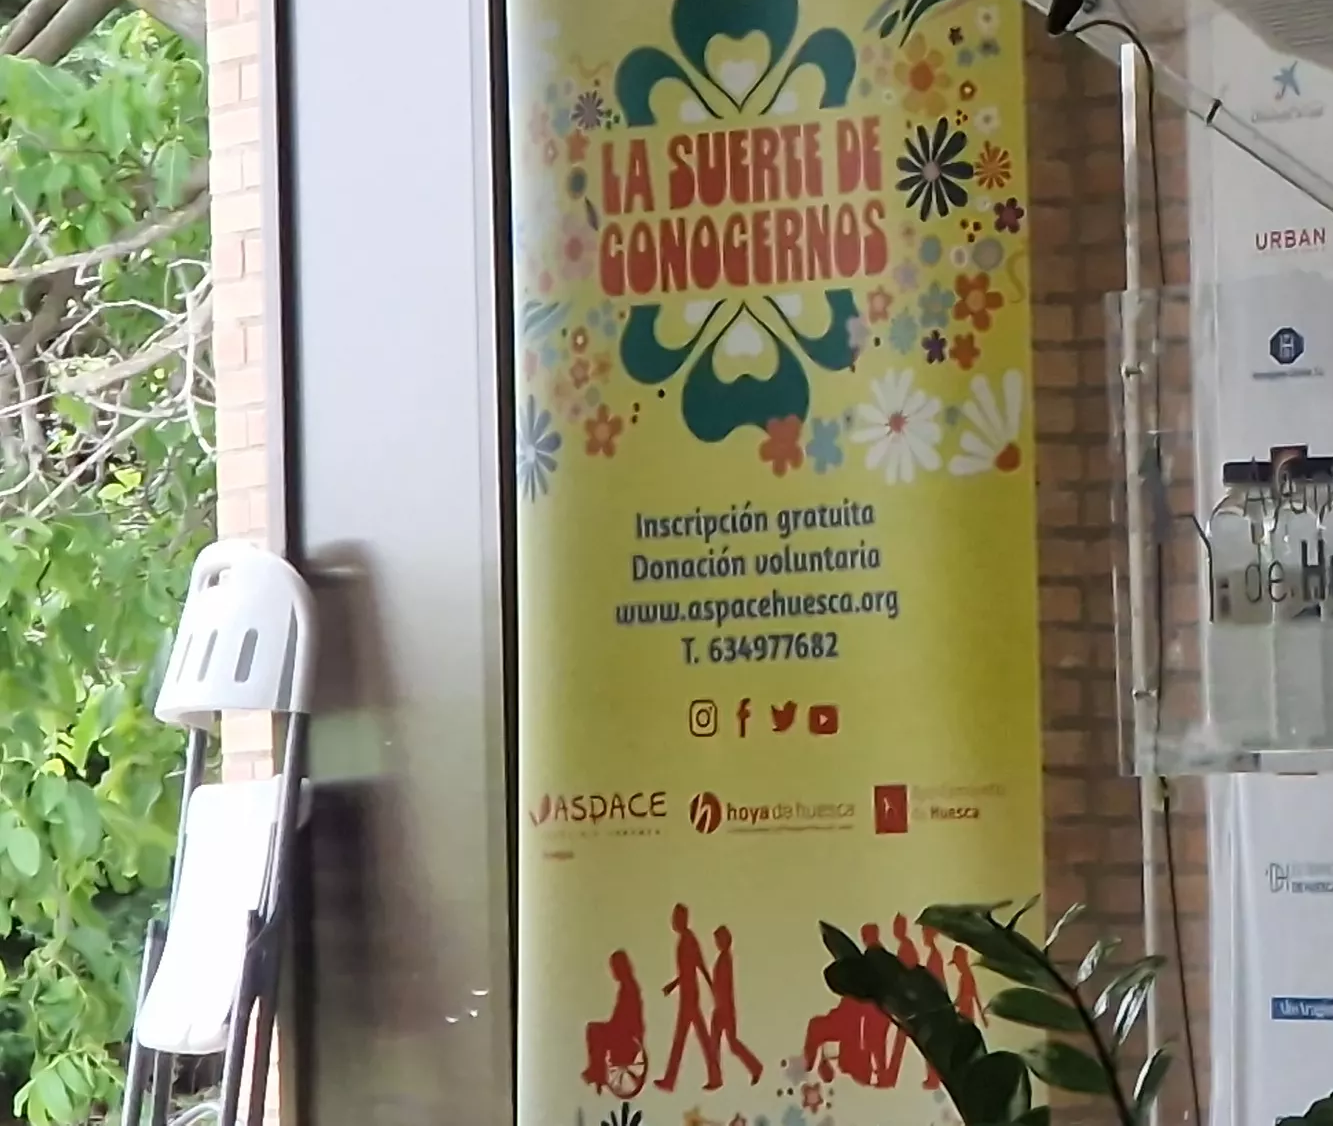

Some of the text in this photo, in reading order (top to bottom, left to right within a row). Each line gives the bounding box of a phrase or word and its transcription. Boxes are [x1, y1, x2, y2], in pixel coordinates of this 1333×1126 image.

[599, 114, 885, 217] LA SUERTE DE
[1254, 227, 1327, 252] URBAN
[634, 497, 877, 544] Inscripción gratuita
[631, 538, 882, 582] Donación voluntaria
[614, 586, 901, 627] www.aspacehuesca.org
[681, 631, 840, 666] T. 634977682
[554, 790, 668, 825] ASPACE
[726, 802, 770, 826] hoya
